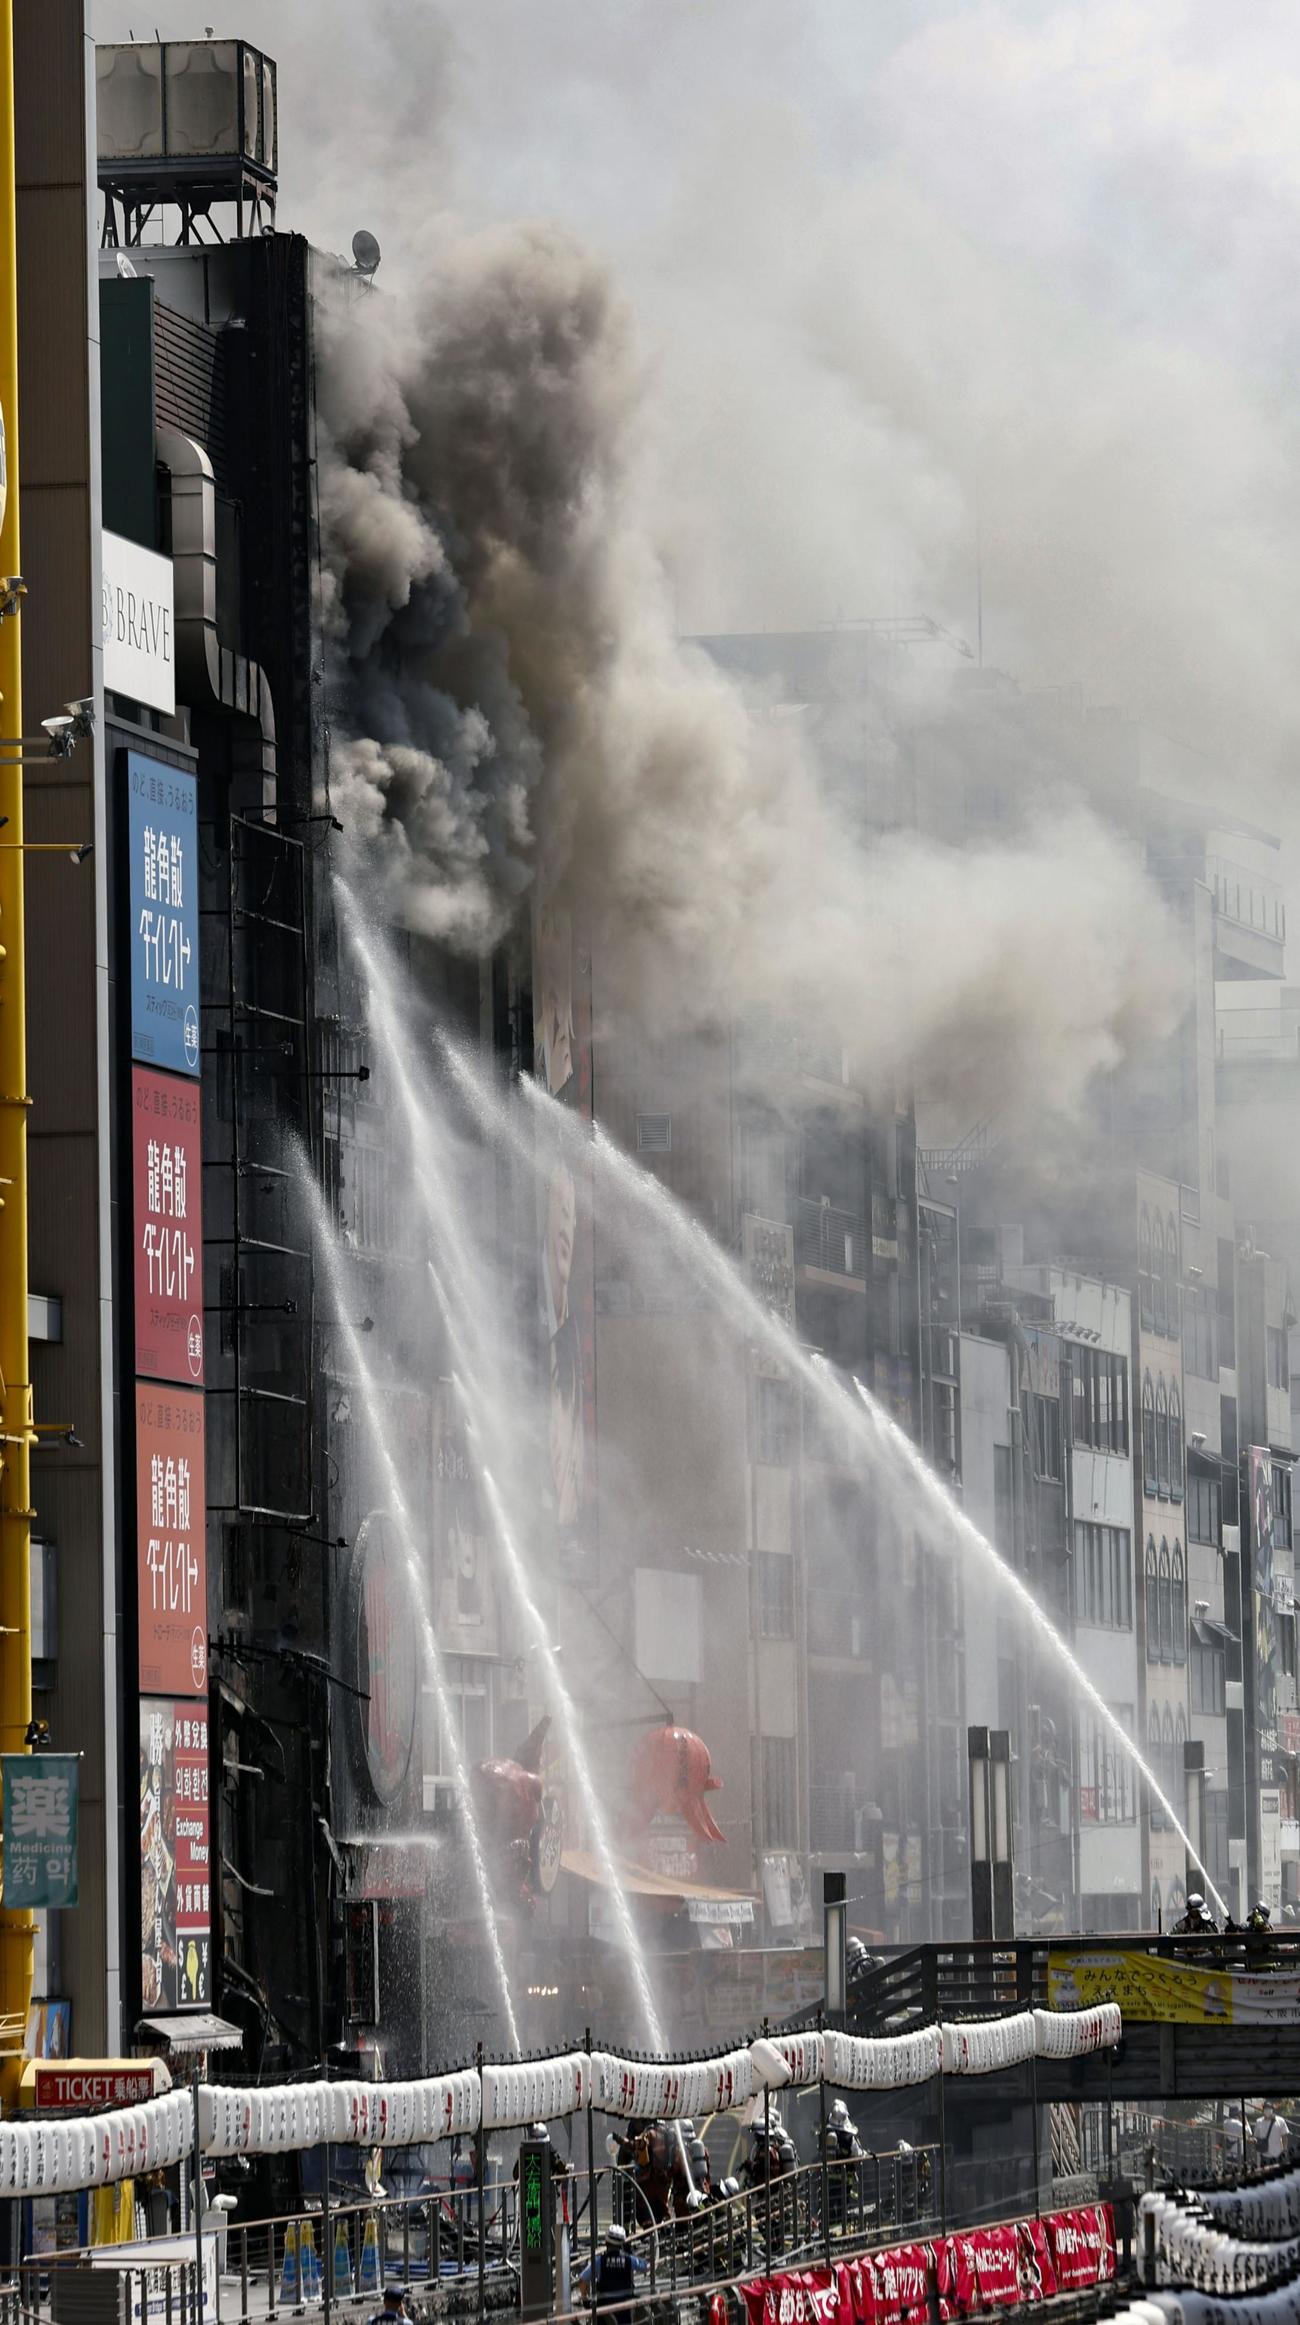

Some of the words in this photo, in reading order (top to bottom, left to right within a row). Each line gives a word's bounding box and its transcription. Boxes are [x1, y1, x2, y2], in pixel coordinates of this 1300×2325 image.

[116, 586, 171, 663] BRAVE
[143, 825, 183, 909] 龍角散
[139, 909, 191, 991] ダイレクト
[147, 1139, 187, 1219] 龍角散
[143, 1223, 194, 1301] ダイレクト
[151, 1454, 191, 1532] 龍角散
[147, 1539, 199, 1613] ダイレクト
[10, 1776, 71, 1838] 薬
[175, 1767, 209, 1801] 외화환전
[10, 1842, 73, 1854] Medicine
[176, 1817, 204, 1840] Exchange
[190, 1841, 209, 1864] Money
[176, 1884, 210, 1913] 外貨両替
[1084, 1968, 1199, 1986] みんなでつくろう
[55, 2077, 114, 2100] TICKET
